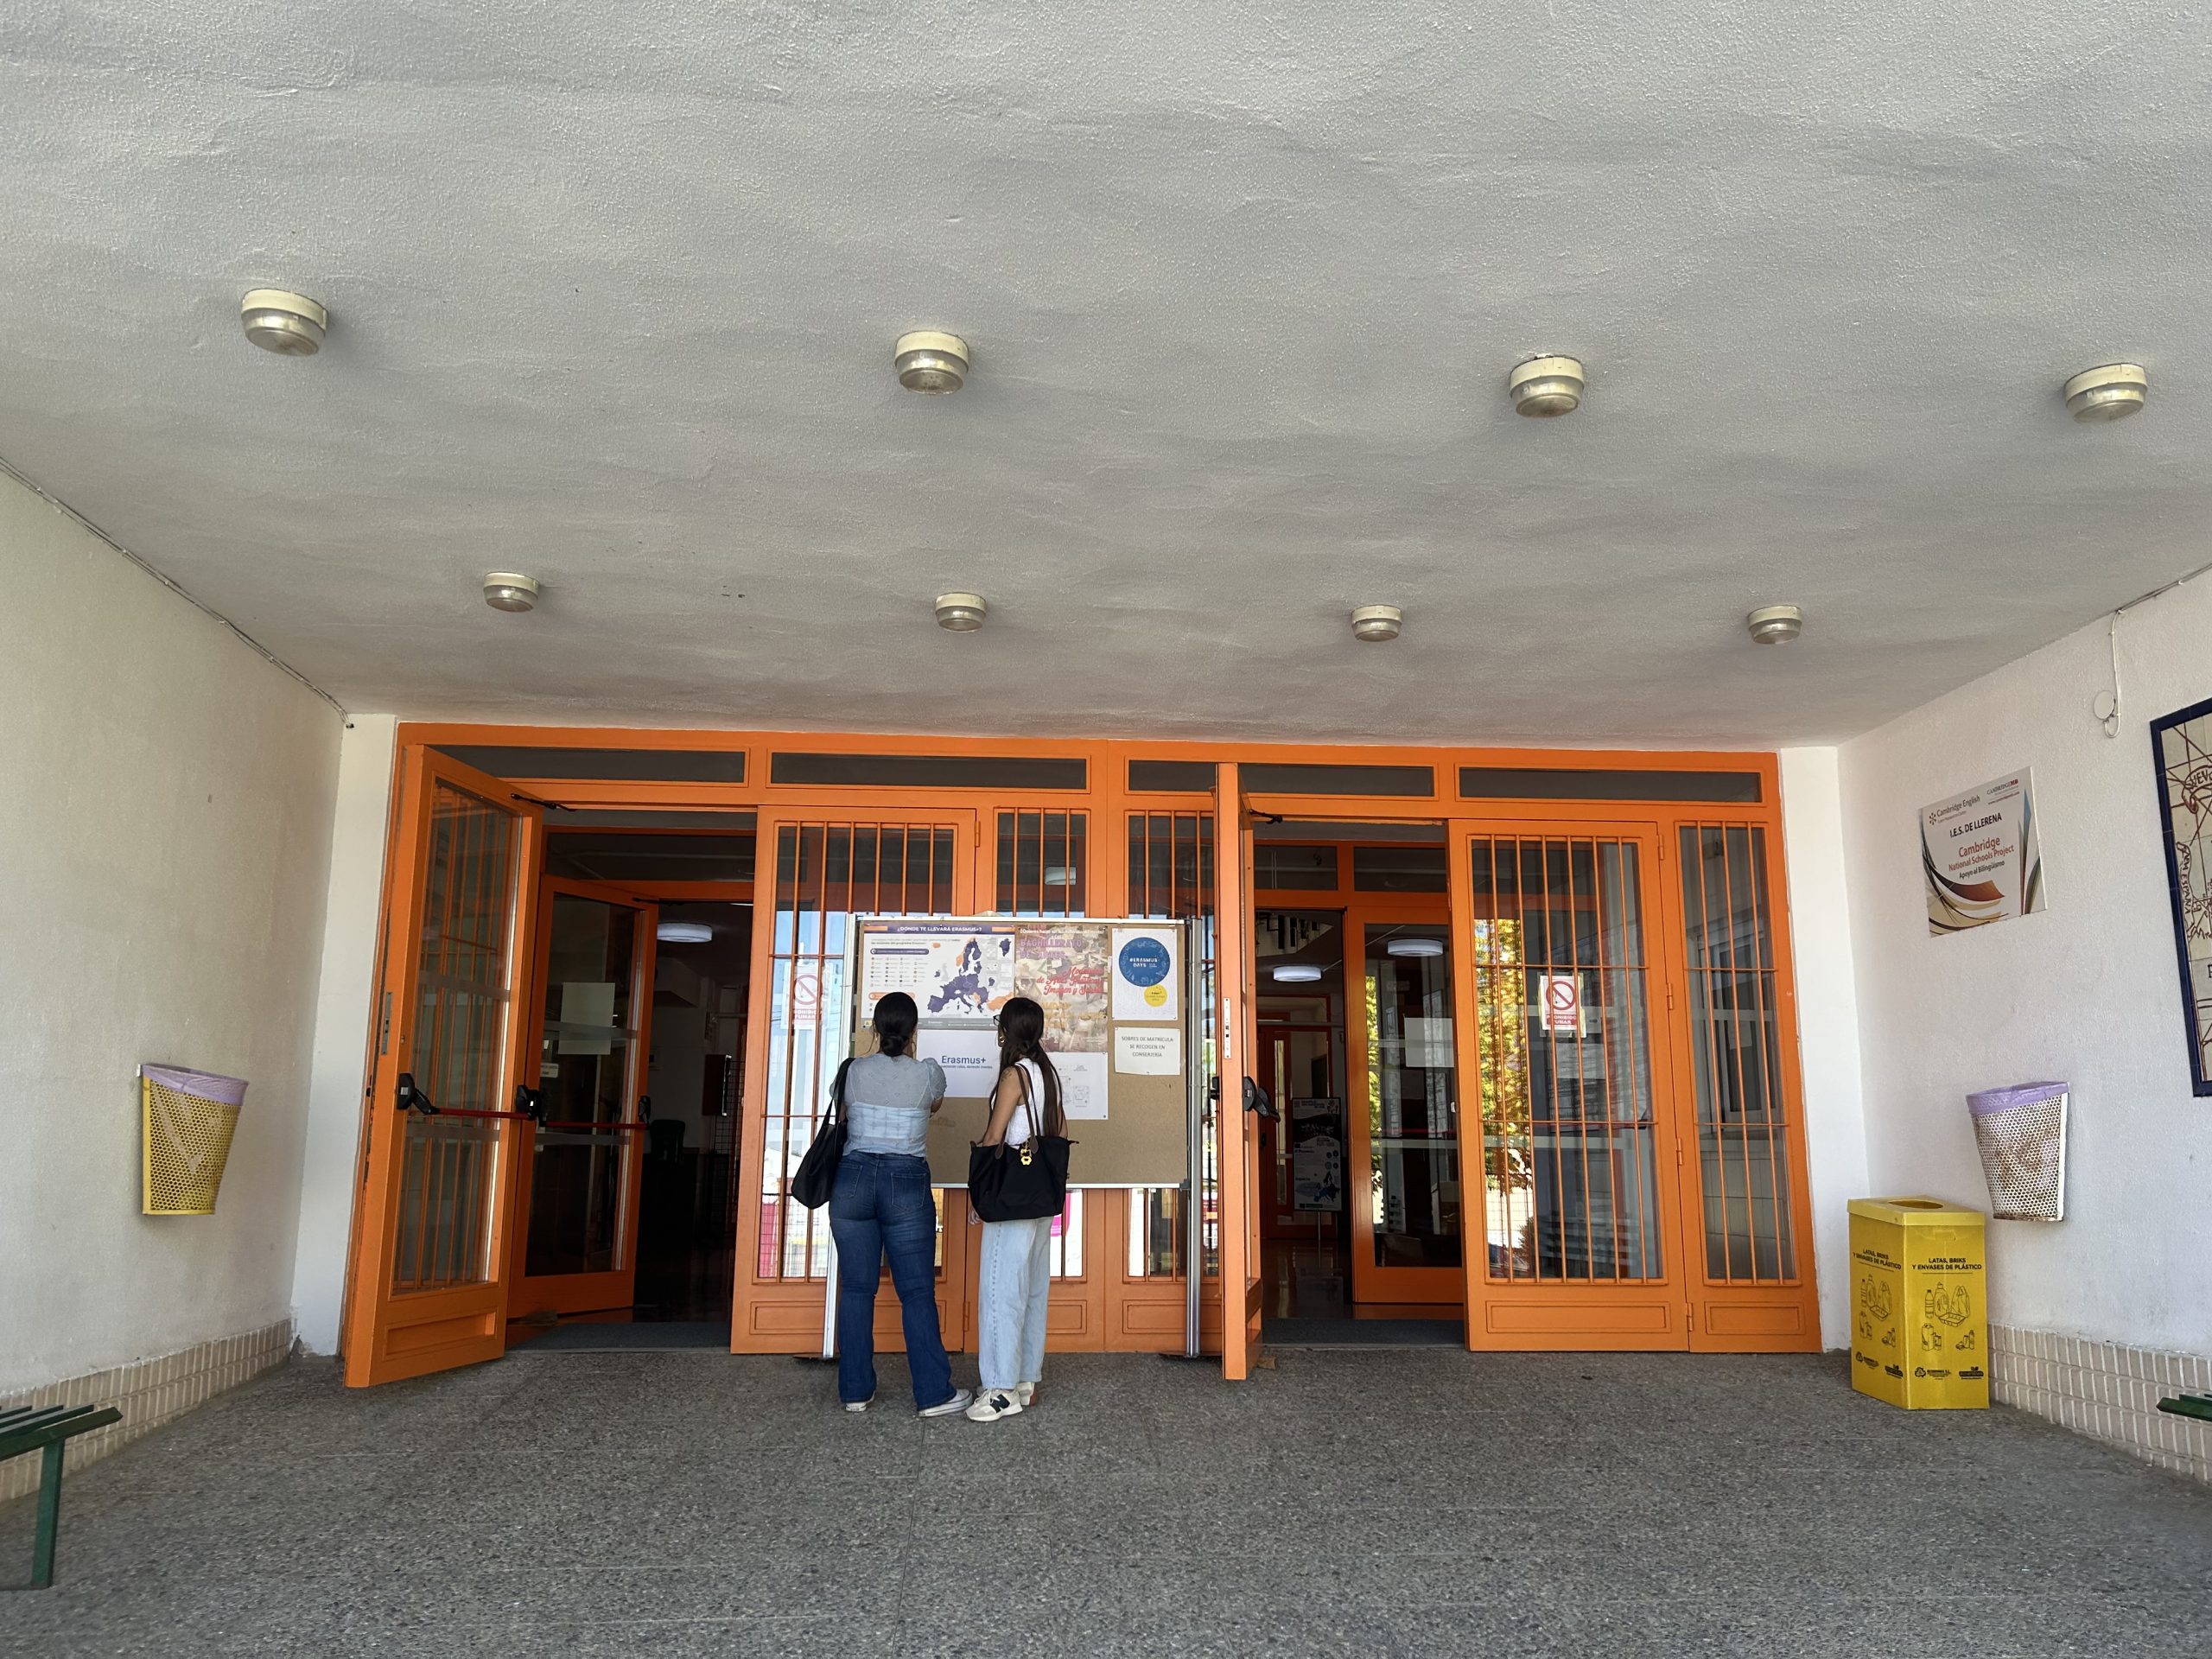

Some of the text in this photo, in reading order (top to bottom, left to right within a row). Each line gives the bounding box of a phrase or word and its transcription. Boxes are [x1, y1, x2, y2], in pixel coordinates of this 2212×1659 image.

[1936, 803, 1962, 817] Cambridge
[1962, 795, 1980, 807] English
[1949, 826, 1964, 838] I.E.S.
[1965, 822, 1974, 833] DE
[1974, 812, 2002, 830] LLERENA
[1948, 844, 2015, 872] National Schools Project
[1959, 837, 2000, 858] Cambridge
[1959, 869, 1973, 880] Apoyo
[941, 1055, 987, 1065] Erasmus+
